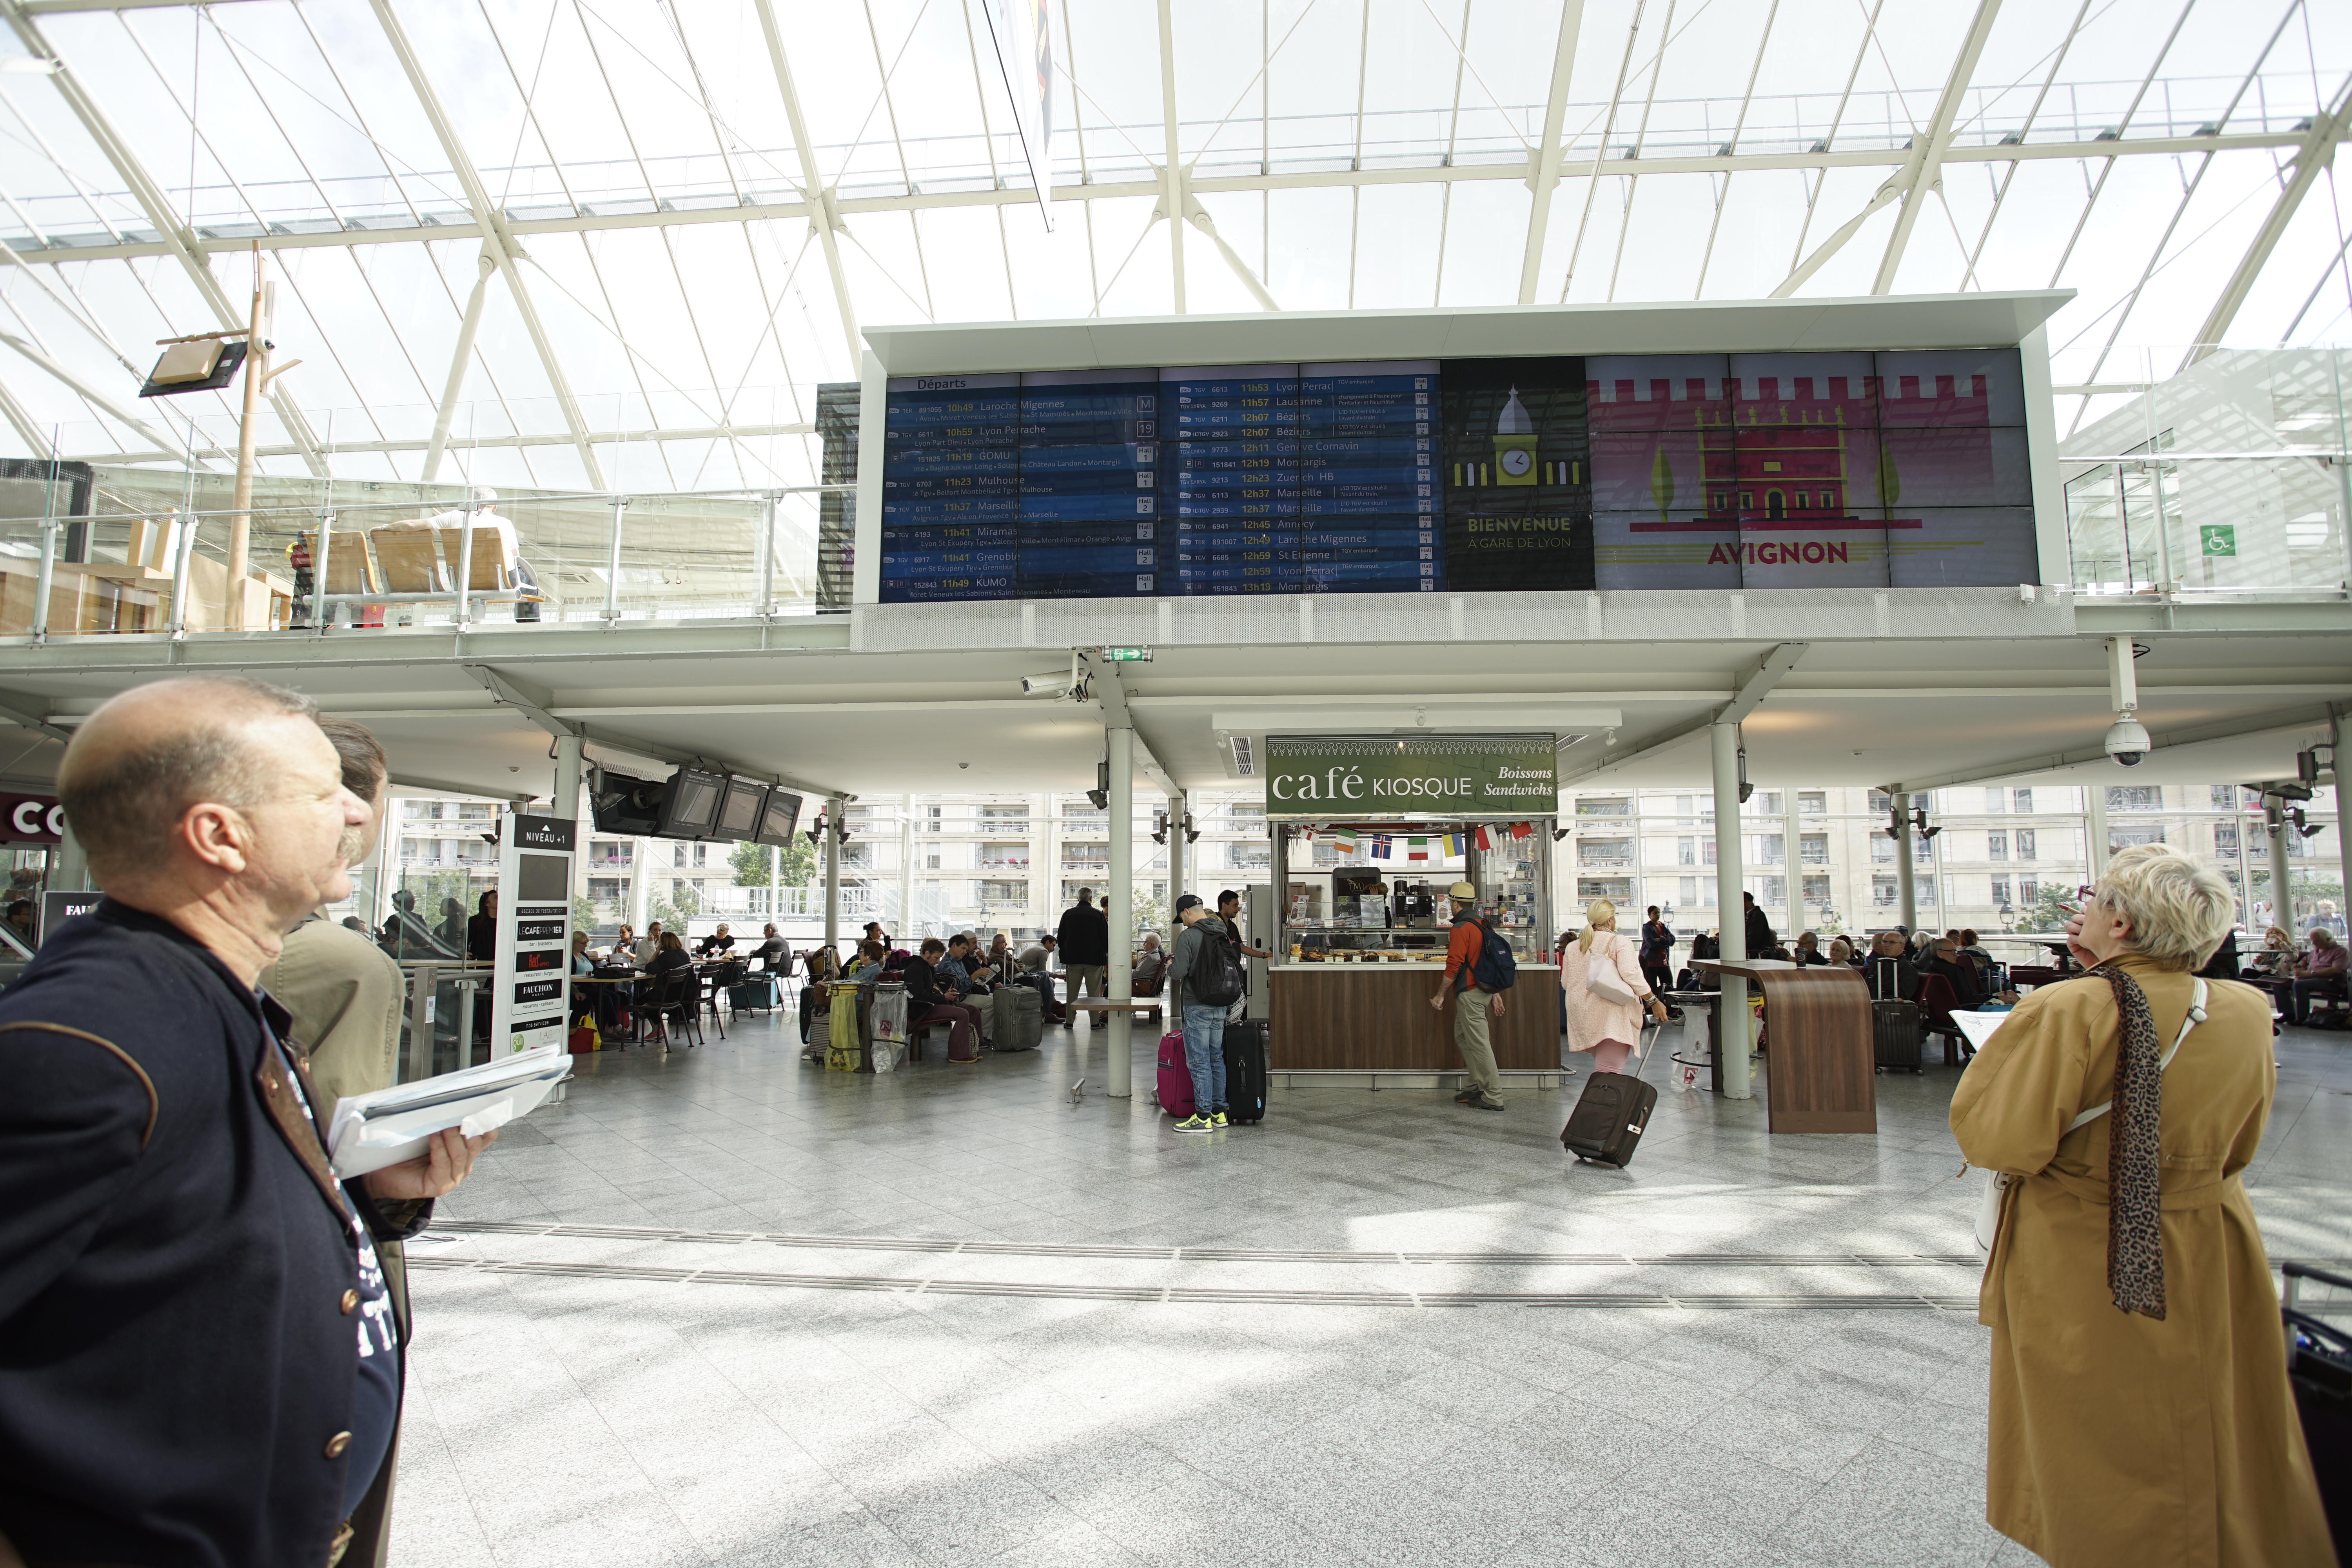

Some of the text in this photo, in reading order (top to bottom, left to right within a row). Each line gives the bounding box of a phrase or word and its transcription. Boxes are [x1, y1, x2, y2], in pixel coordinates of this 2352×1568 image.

[918, 379, 966, 390] Départs
[1277, 383, 1298, 393] Lyon
[981, 402, 1016, 410] Laroche
[1020, 401, 1064, 411] Migennes
[1141, 400, 1150, 408] M
[1277, 397, 1322, 406] Lausanne
[1277, 412, 1310, 421] Béziers
[980, 427, 1002, 436] Lyon
[1005, 425, 1045, 434] Perrache
[1140, 424, 1151, 433] 19
[1277, 443, 1313, 451] Genève
[1316, 441, 1359, 450] Cornavin
[946, 453, 972, 461] 11h19
[979, 452, 1010, 460] GOMU
[1277, 457, 1326, 468] Montargis
[1277, 472, 1313, 482] Zuerich
[1320, 472, 1334, 481] HB
[1278, 488, 1321, 497] Marseille
[978, 501, 1020, 510] Marseille
[1278, 503, 1321, 512] Marseille
[1278, 520, 1314, 530] Annecy
[1468, 517, 1570, 532] BIENVENUE
[944, 528, 970, 537] 11h41
[978, 527, 1017, 536] Miramas
[1278, 535, 1317, 544] Laroche
[1320, 534, 1367, 545] Migennes
[1468, 536, 1570, 548] À GARE DE LYON
[977, 552, 1020, 561] Grenoble
[1242, 552, 1270, 560] 12h59
[1279, 551, 1288, 559] St
[1292, 551, 1330, 559] Etienne
[1708, 542, 1847, 564] AVIGNON
[1243, 567, 1270, 575] 12h59
[1279, 566, 1301, 577] Lyon
[942, 579, 969, 587] 11h49
[976, 578, 1006, 587] KUMO
[1243, 583, 1270, 591] 13h19
[1279, 582, 1328, 592] Montargis
[1497, 766, 1552, 779] Boissons
[1272, 766, 1472, 800] café KIOSQUE
[1484, 783, 1552, 796] Sandwichs
[526, 832, 554, 843] NIVEAU
[523, 984, 553, 994] FAUCHON
[539, 1030, 552, 1040] LAB
